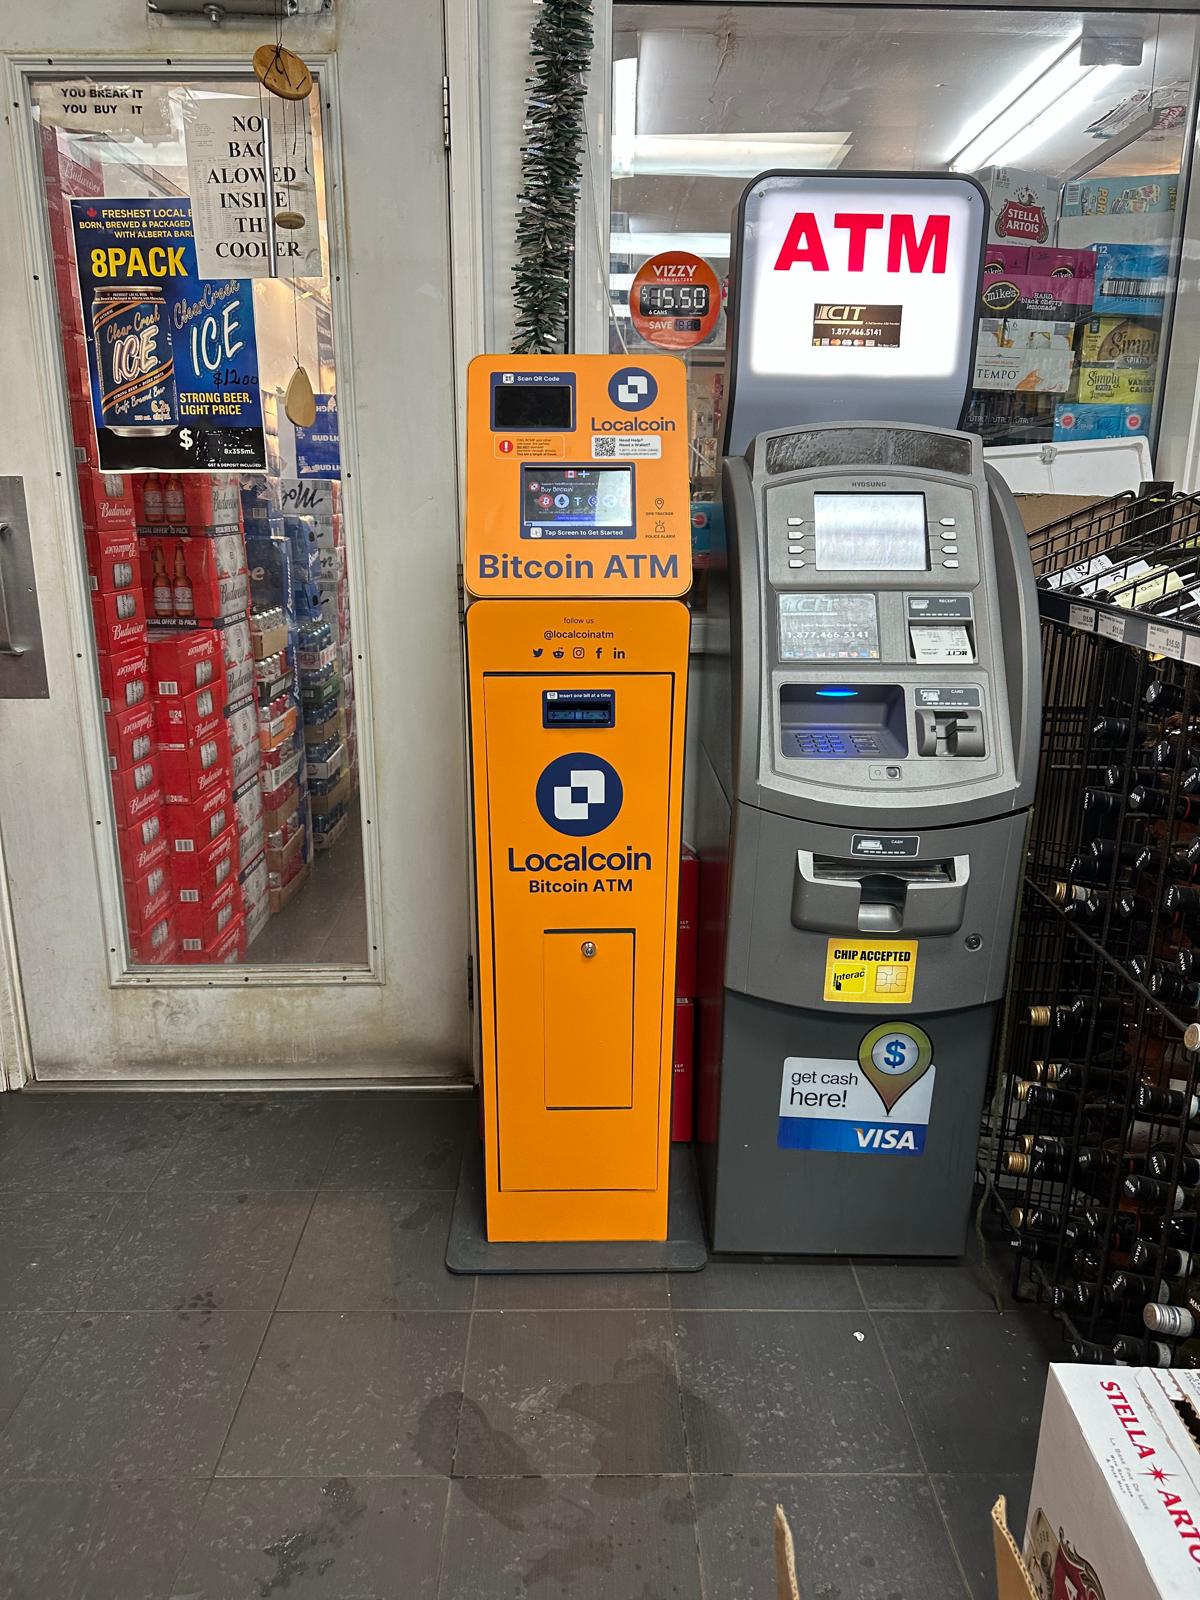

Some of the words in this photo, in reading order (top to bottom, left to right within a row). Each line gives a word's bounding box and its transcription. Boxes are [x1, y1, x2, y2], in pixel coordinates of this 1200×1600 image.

[61, 88, 86, 98] YOU
[89, 89, 129, 98] BREAK
[132, 89, 144, 99] IT
[63, 104, 87, 114] YOU
[94, 105, 117, 114] BUY
[131, 105, 143, 114] IT
[232, 115, 263, 133] NO
[220, 191, 288, 209] INSIE
[101, 209, 152, 219] FRESHEST
[153, 208, 186, 218] LOCAL
[1007, 208, 1040, 223] STELLA
[79, 221, 105, 230] BORN,
[106, 221, 140, 229] BREWED
[148, 220, 191, 228] PACKAGED
[234, 218, 269, 233] TH
[1006, 219, 1040, 233] ARTOIS
[114, 231, 136, 239] WITH
[137, 230, 173, 238] ALBERTA
[773, 212, 951, 274] ATM
[1099, 246, 1108, 254] 12
[90, 246, 189, 278] 8PACK
[652, 264, 699, 277] VIZZY
[986, 288, 1018, 302] mike's
[1034, 292, 1053, 300] HARD
[106, 322, 133, 344] Clear
[133, 303, 161, 332] Creek
[649, 321, 673, 329] SAVE
[192, 300, 244, 377] ICE
[831, 328, 882, 336] 1.877.466.5141
[112, 324, 160, 385] ICE
[976, 368, 1017, 380] TEMPO
[179, 392, 221, 403] STRONG
[223, 392, 253, 404] BEER,
[180, 404, 210, 415] LIGHT
[212, 404, 242, 415] PRICE
[591, 416, 676, 432] Localcoin
[179, 427, 194, 451] $
[311, 434, 329, 442] BUD
[100, 502, 133, 518] Budweiser
[479, 553, 594, 579] Bitcoin
[603, 554, 679, 579] ATM
[112, 623, 144, 641] Budweiser
[543, 630, 614, 640] @localcoinatm
[787, 631, 869, 639] 1.877.466.5141
[508, 845, 652, 872] Localcoin
[529, 880, 588, 893] Bitcoin
[592, 879, 633, 892] ATM
[834, 949, 858, 960] CHIP
[859, 950, 911, 961] ACCEPTED
[833, 970, 865, 981] Interac
[791, 1071, 816, 1085] get
[820, 1073, 859, 1085] cash
[790, 1087, 848, 1108] here!
[854, 1127, 916, 1150] VISA
[1099, 1380, 1156, 1460] STELLA
